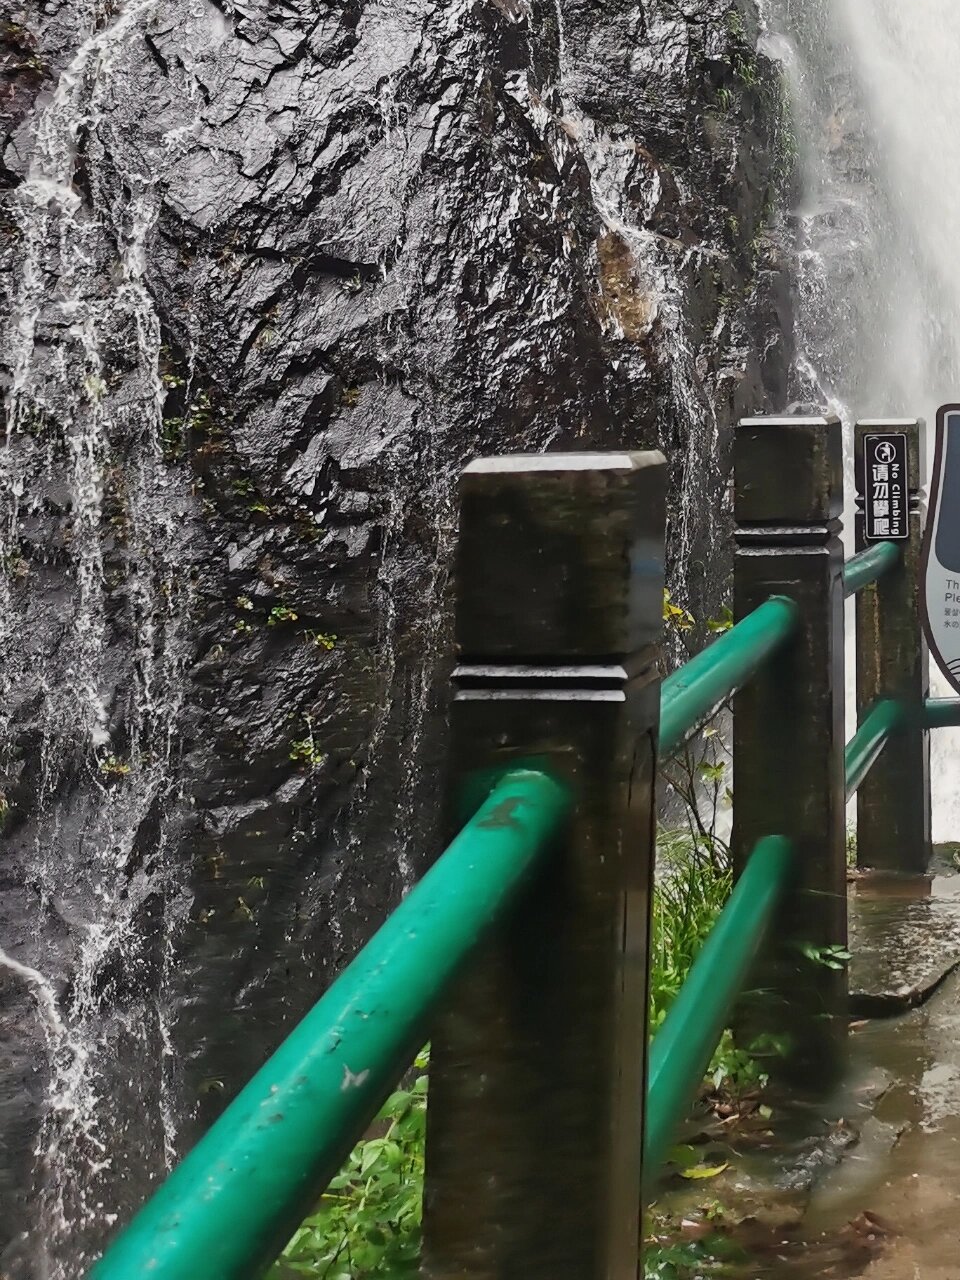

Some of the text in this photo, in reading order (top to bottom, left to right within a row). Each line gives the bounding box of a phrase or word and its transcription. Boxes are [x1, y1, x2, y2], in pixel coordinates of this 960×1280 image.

[872, 464, 890, 535] 请勿攀爬
[891, 463, 901, 535] No Climbing
